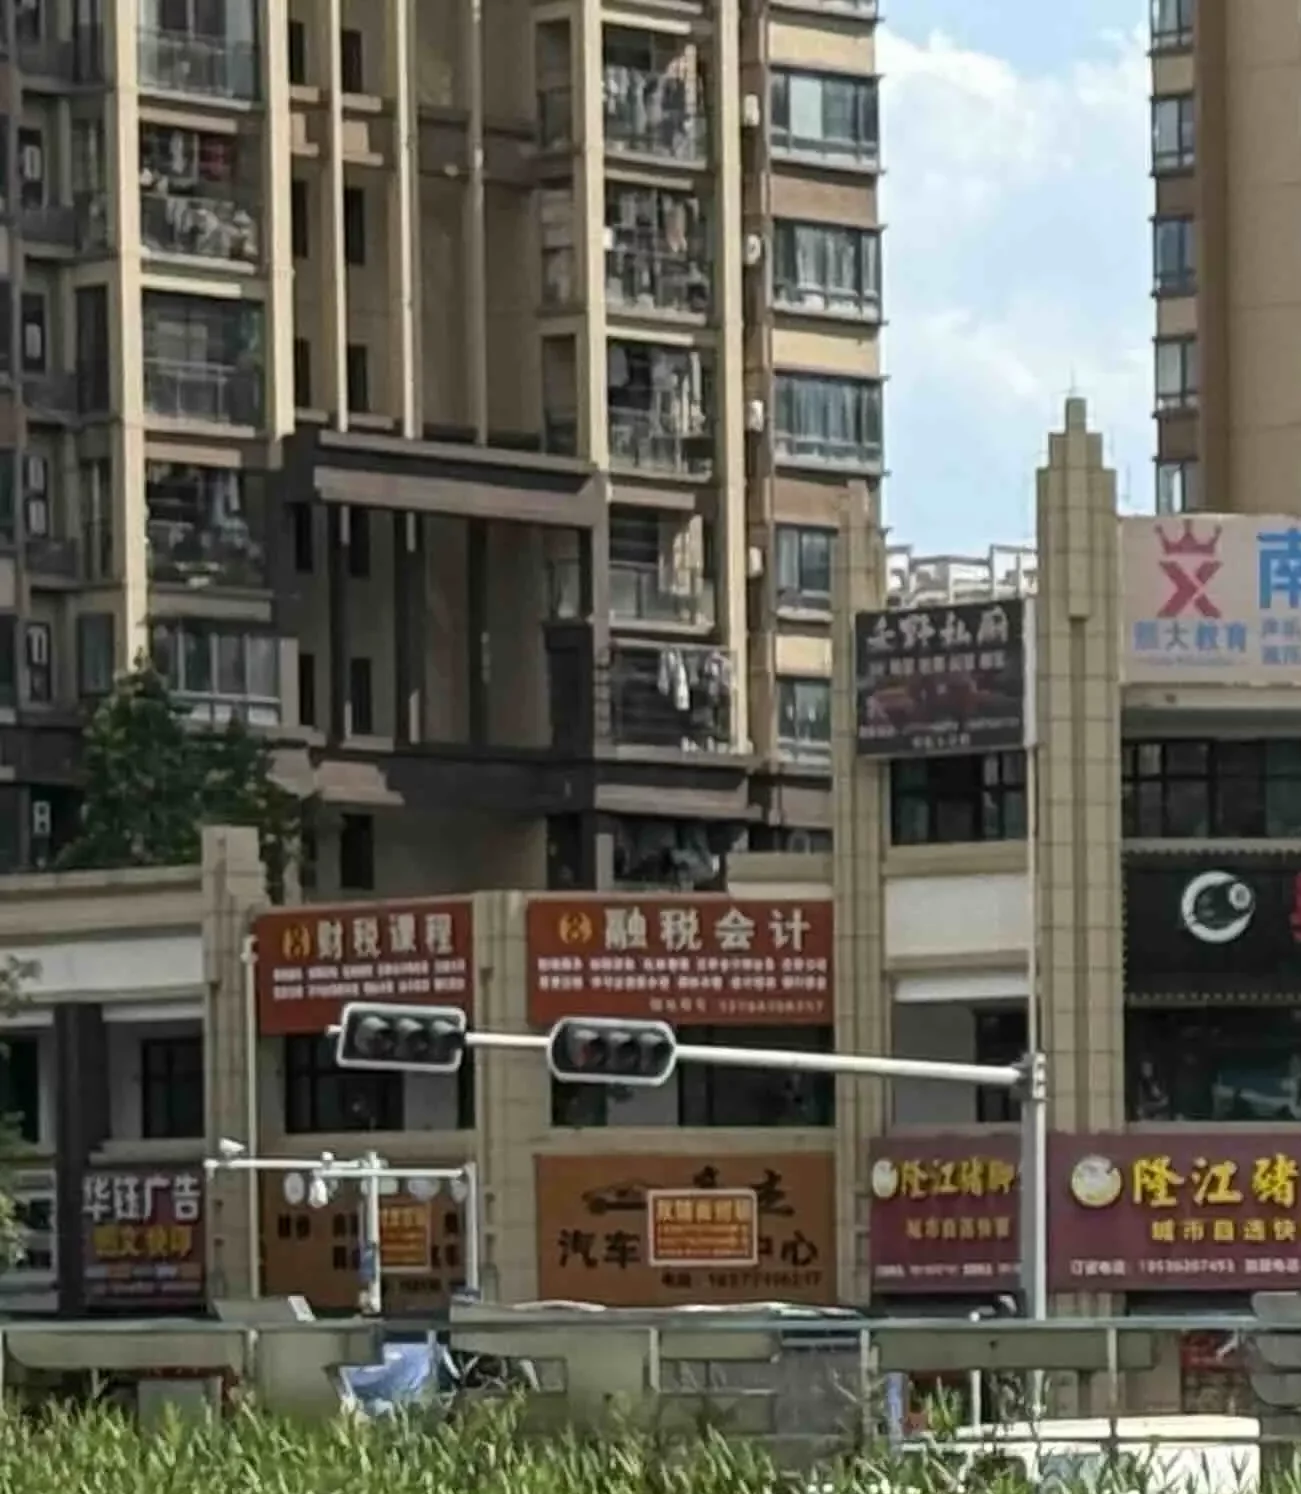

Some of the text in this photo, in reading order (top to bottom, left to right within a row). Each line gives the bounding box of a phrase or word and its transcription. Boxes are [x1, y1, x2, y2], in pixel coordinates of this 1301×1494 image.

[316, 913, 456, 960] 财税课程
[603, 906, 812, 952] 融税会计
[900, 1157, 1024, 1199] 隆江猪脚
